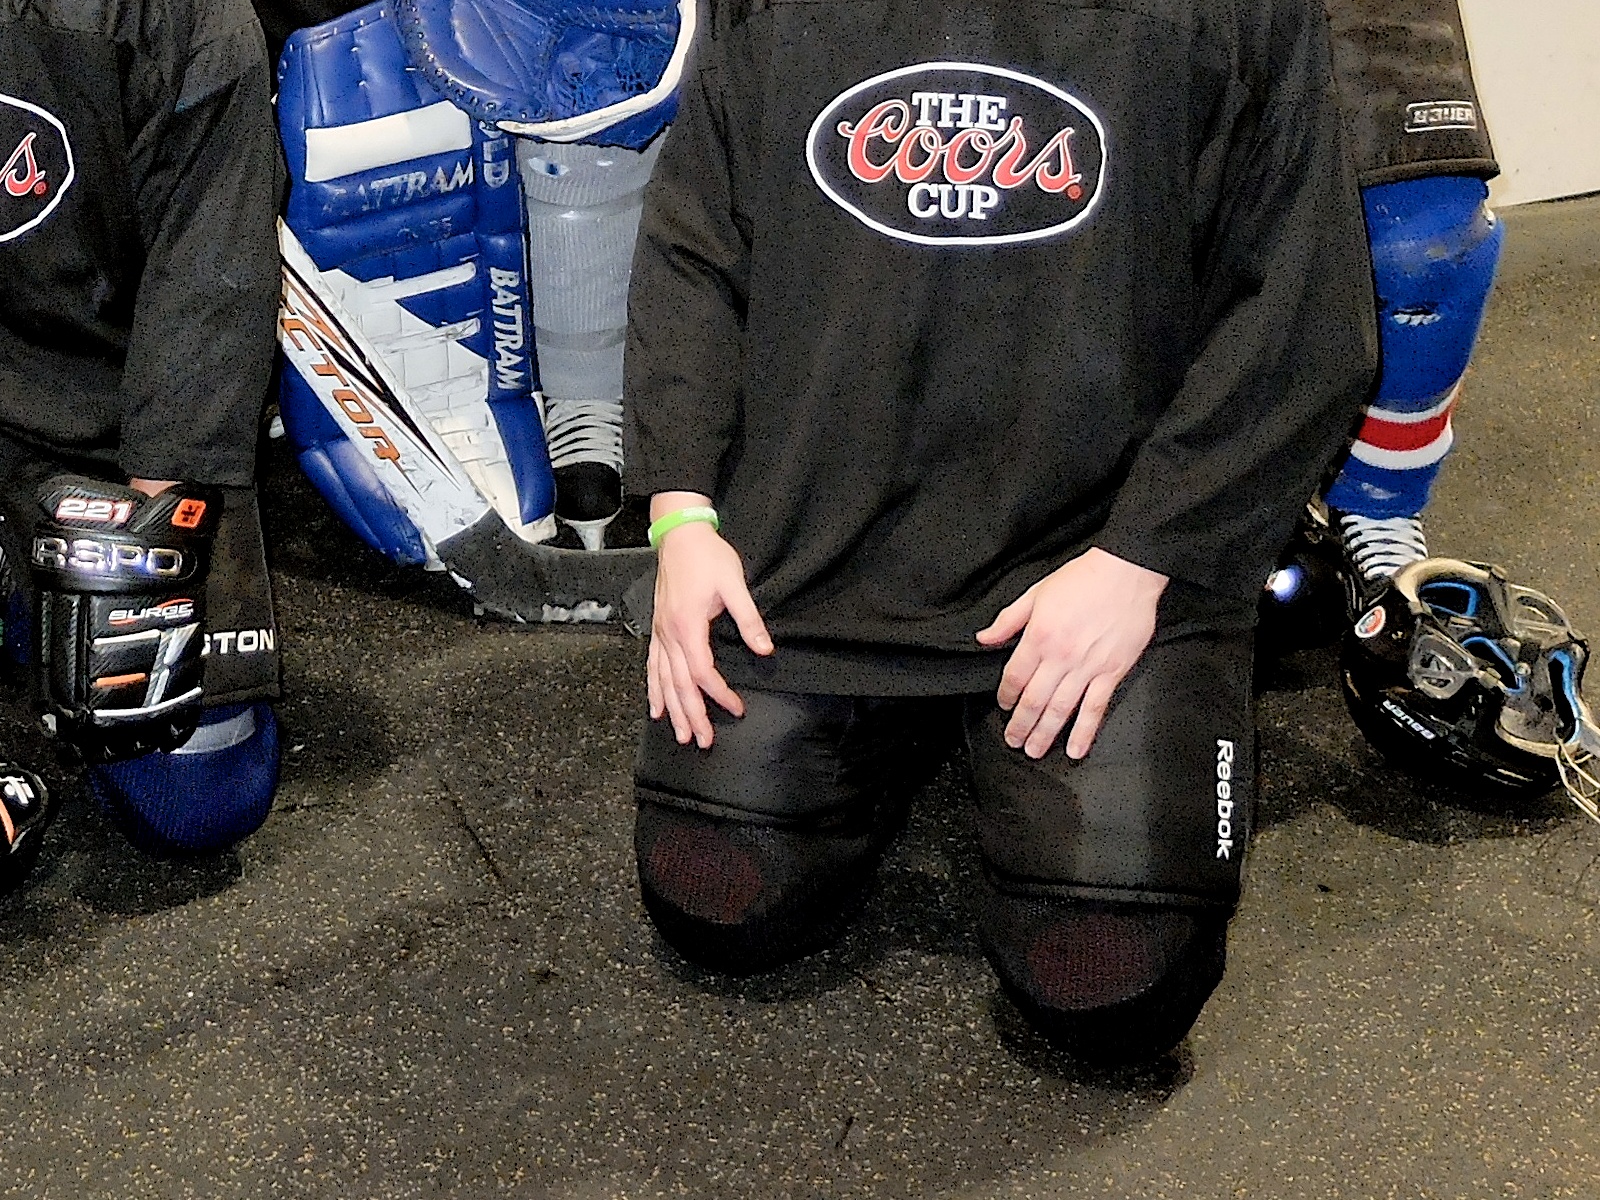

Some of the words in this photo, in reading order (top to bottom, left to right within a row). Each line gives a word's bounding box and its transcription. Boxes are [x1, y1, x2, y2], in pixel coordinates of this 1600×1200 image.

[912, 92, 1007, 131] THE
[836, 99, 1082, 194] Coors
[907, 183, 999, 220] CUP
[489, 267, 525, 391] BATTRAM
[279, 294, 401, 461] CTOR
[58, 499, 131, 522] 221
[108, 602, 195, 622] SURGE
[1215, 738, 1234, 861] Reebok
